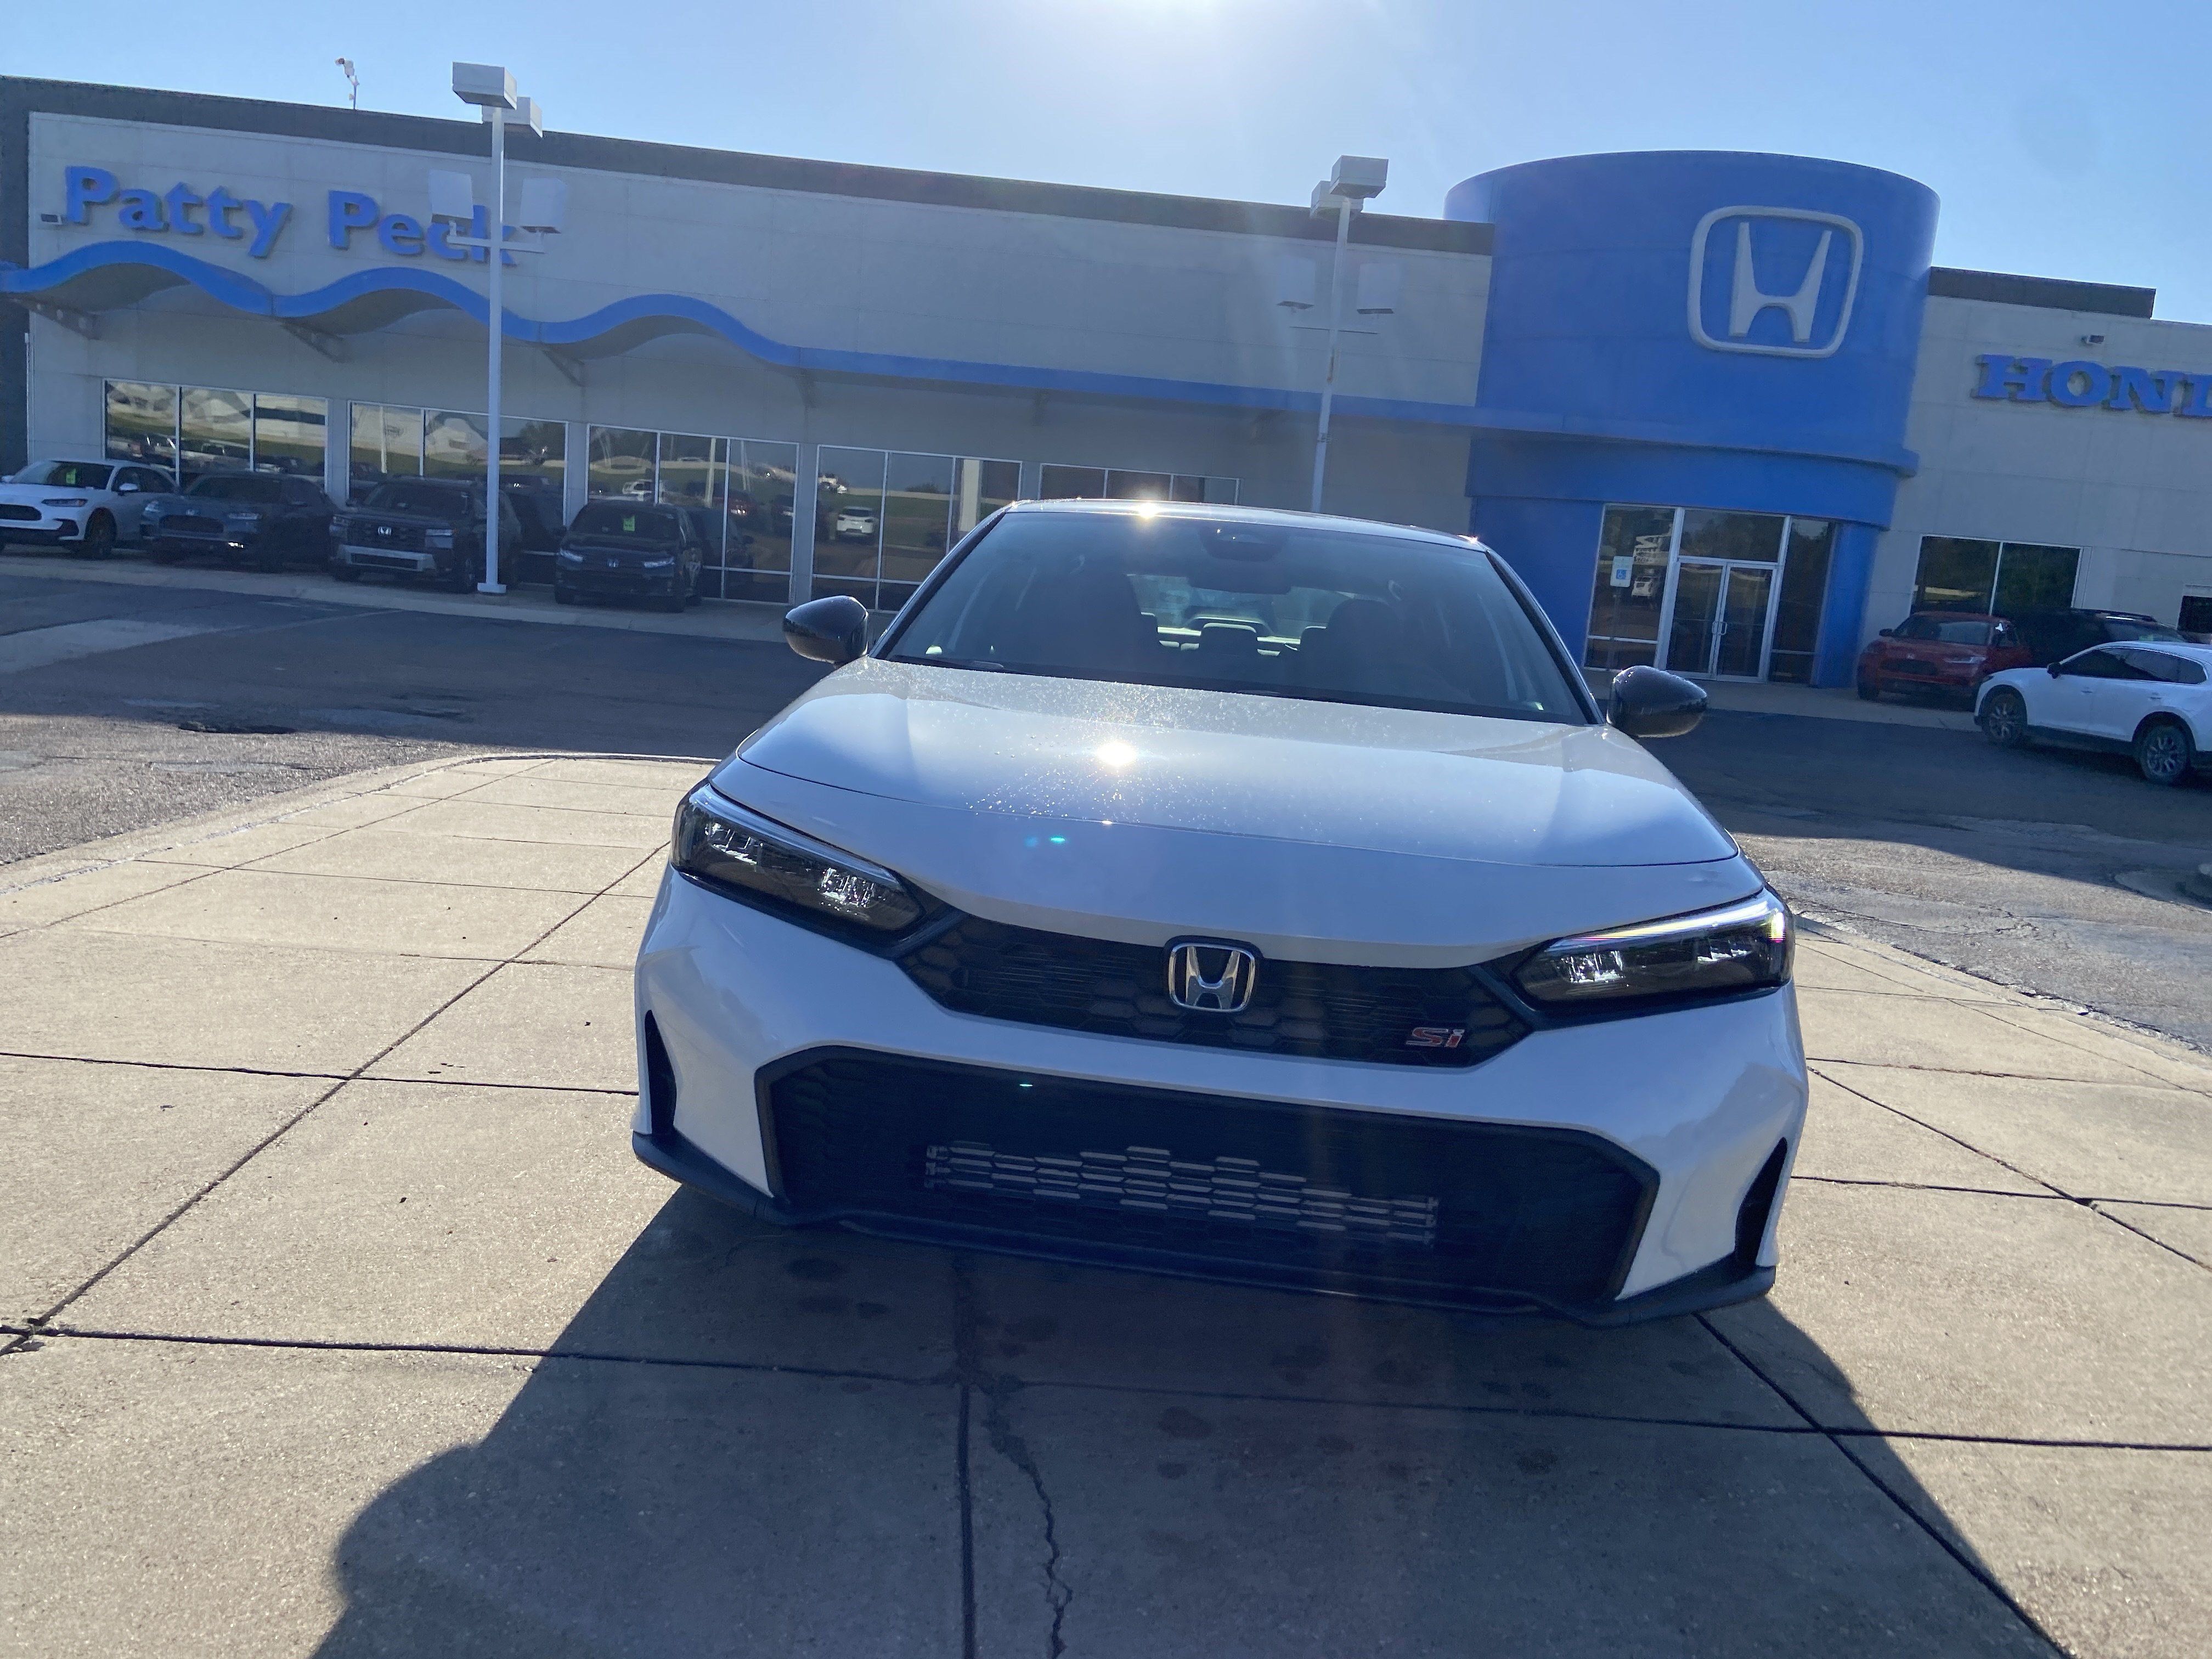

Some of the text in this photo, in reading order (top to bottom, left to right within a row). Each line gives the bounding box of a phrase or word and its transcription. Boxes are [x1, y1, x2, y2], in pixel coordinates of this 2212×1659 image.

[65, 166, 517, 266] Patty Peck
[1405, 1027, 1465, 1048] Si
